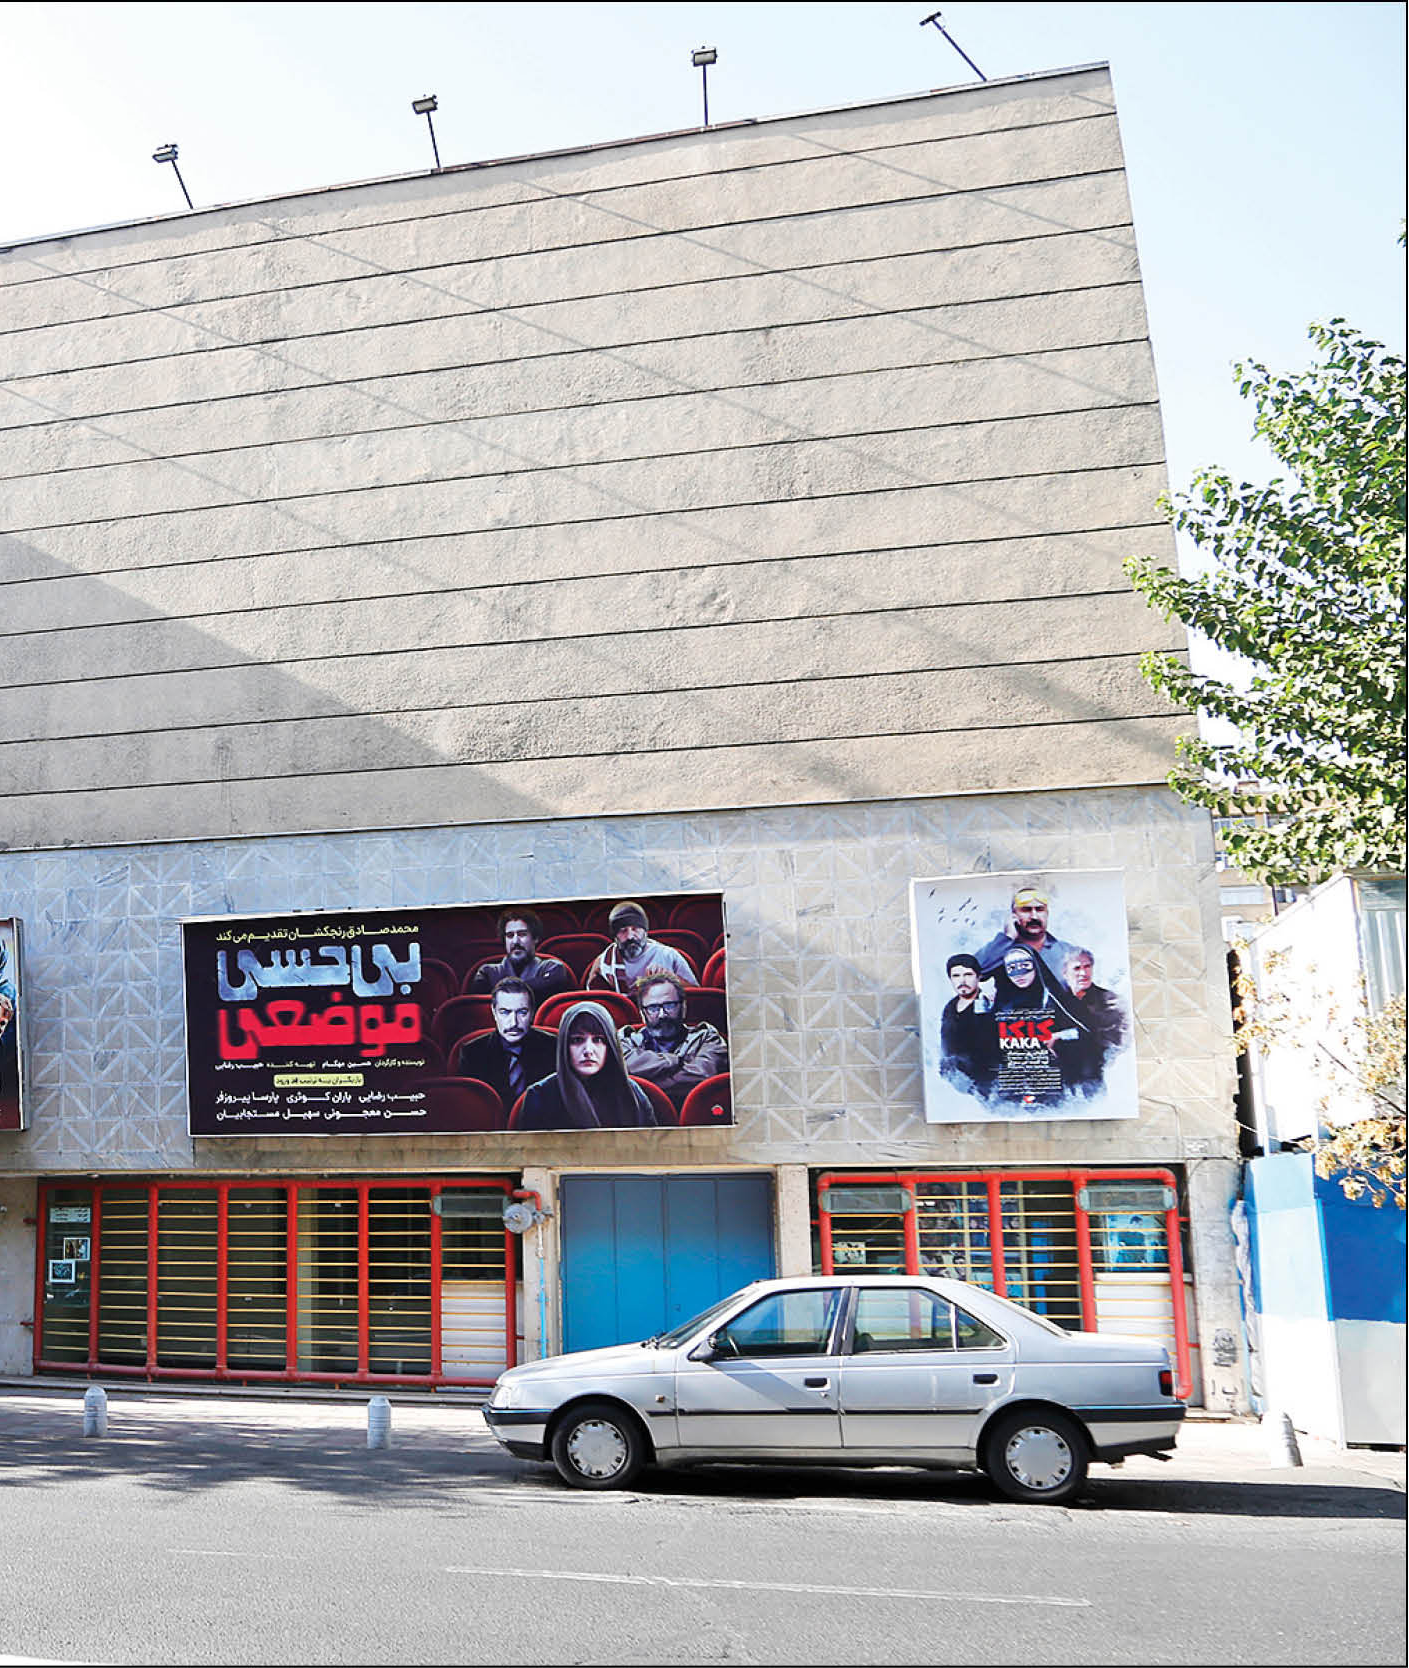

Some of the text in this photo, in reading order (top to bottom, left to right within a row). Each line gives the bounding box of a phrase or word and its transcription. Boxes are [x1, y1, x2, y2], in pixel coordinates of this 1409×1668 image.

[247, 928, 288, 944] تقدیم
[217, 992, 422, 1060] موضعی
[999, 1037, 1041, 1049] KAKA
[251, 1091, 280, 1104] پارسا
[285, 1090, 331, 1104] کوثری
[387, 1091, 426, 1102] حبیب
[282, 1108, 321, 1120] سهیل
[383, 1108, 427, 1119] حسن
